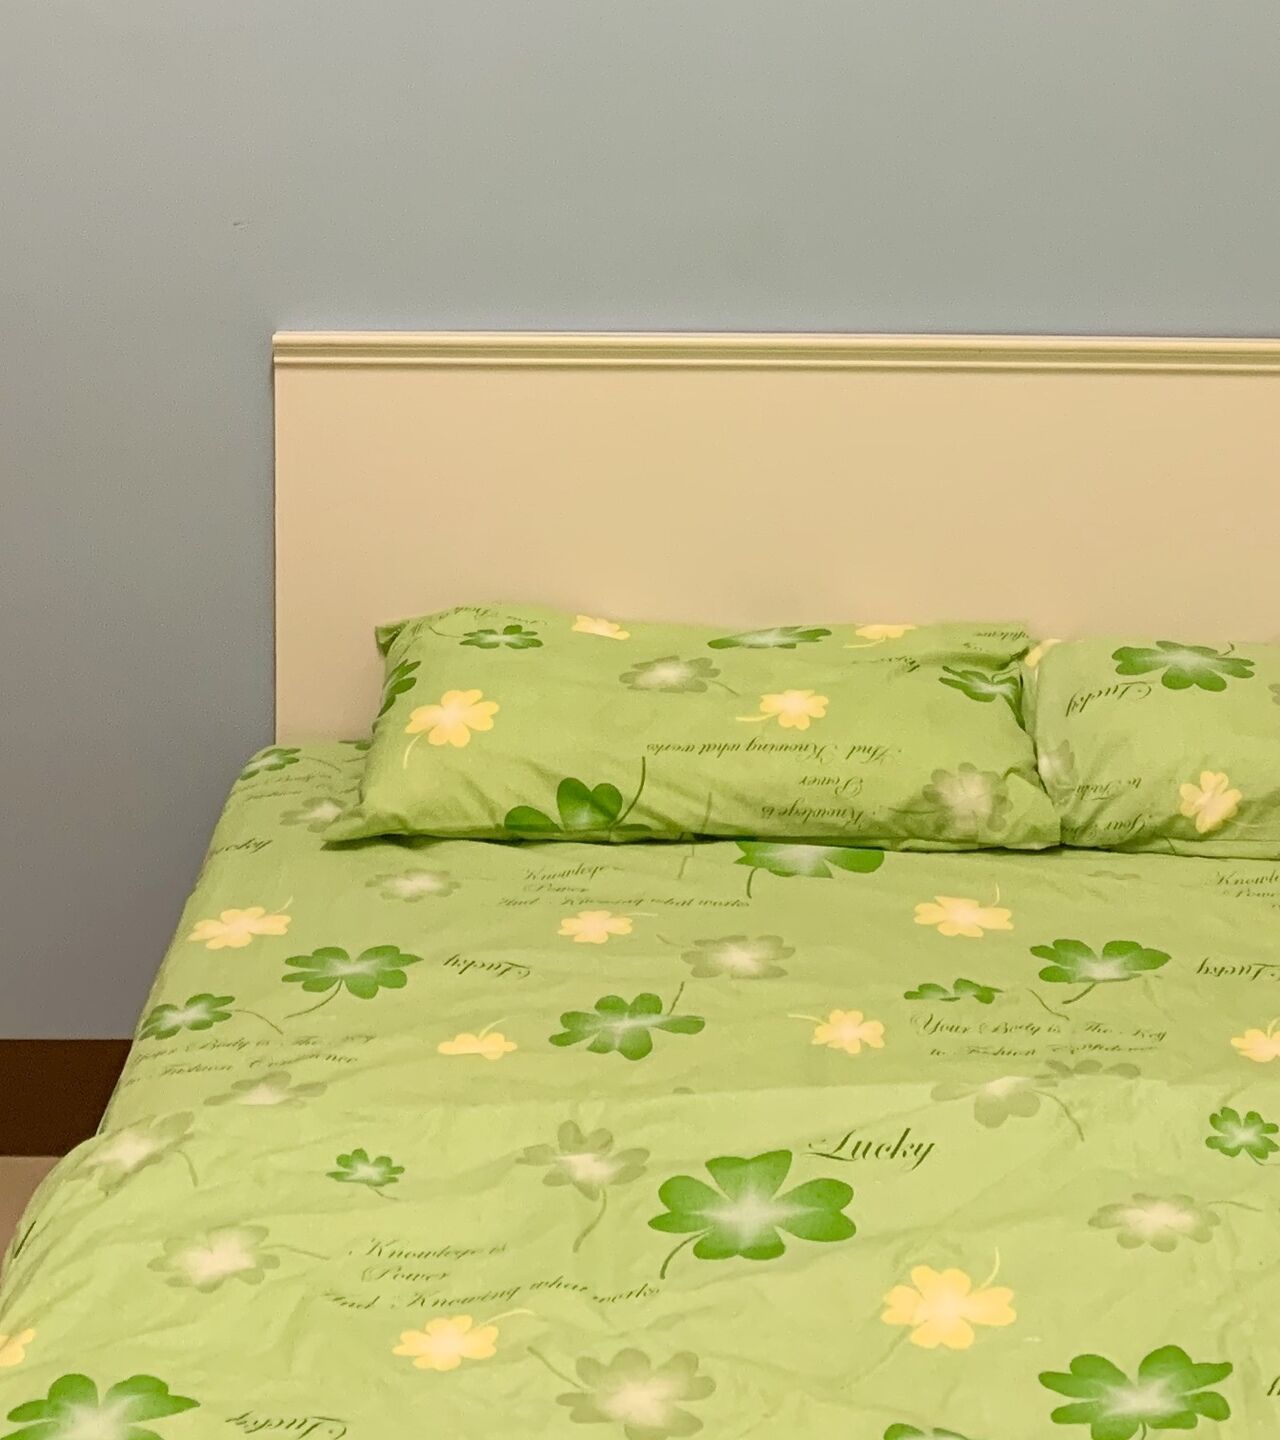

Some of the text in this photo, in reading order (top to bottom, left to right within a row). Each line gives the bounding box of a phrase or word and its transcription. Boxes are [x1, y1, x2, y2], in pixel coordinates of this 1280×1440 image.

[1065, 681, 1158, 719] Lucky
[646, 737, 901, 766] And Knowing what works
[798, 775, 864, 800] Power
[760, 806, 776, 821] is
[442, 953, 532, 981] Lucky
[800, 1127, 935, 1173] Lucky
[225, 1410, 351, 1440] Lucky
